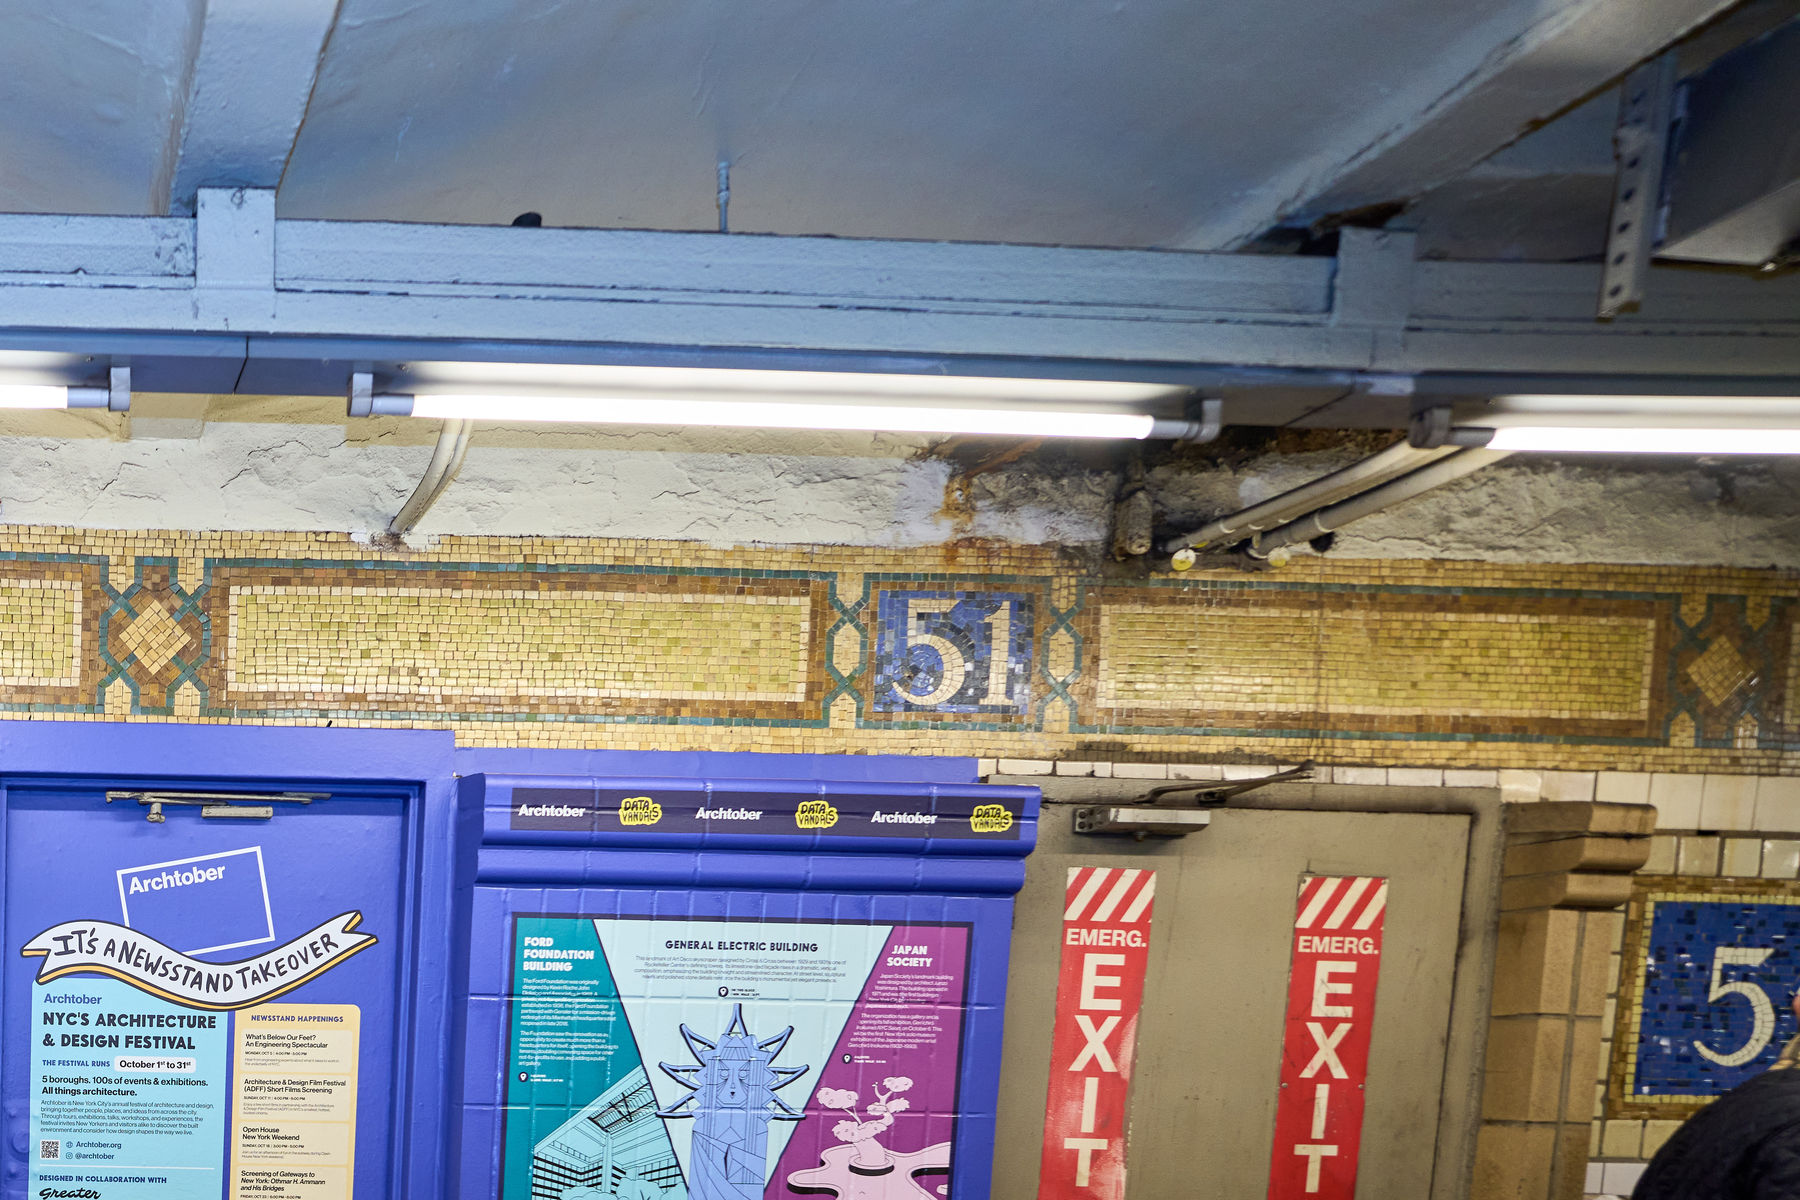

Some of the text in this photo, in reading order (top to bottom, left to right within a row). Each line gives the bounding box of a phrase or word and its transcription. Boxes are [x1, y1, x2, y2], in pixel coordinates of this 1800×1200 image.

[892, 599, 1014, 706] 51
[129, 864, 226, 895] Archtober
[524, 936, 554, 948] FORD
[665, 939, 818, 953] GENERAL ELECTRIC BUILDING
[1066, 928, 1147, 948] EMERG.
[1297, 936, 1379, 955] EMERG.
[523, 948, 595, 961] FOUNDATION
[891, 944, 928, 956] JAPAN
[52, 927, 339, 993] IT'S A NEWSSTAND TAKEOVER
[523, 961, 573, 972] BUILDING
[886, 955, 934, 968] SOCIETY
[43, 993, 102, 1005] Archtober
[42, 1012, 217, 1029] NYC'S ARCHITECTURE
[42, 1034, 196, 1050] & DESIGN FESTIVAL
[119, 1060, 155, 1069] October
[166, 1061, 175, 1069] to
[1064, 953, 1126, 1187] EXIT
[1294, 960, 1358, 1193] EXIT
